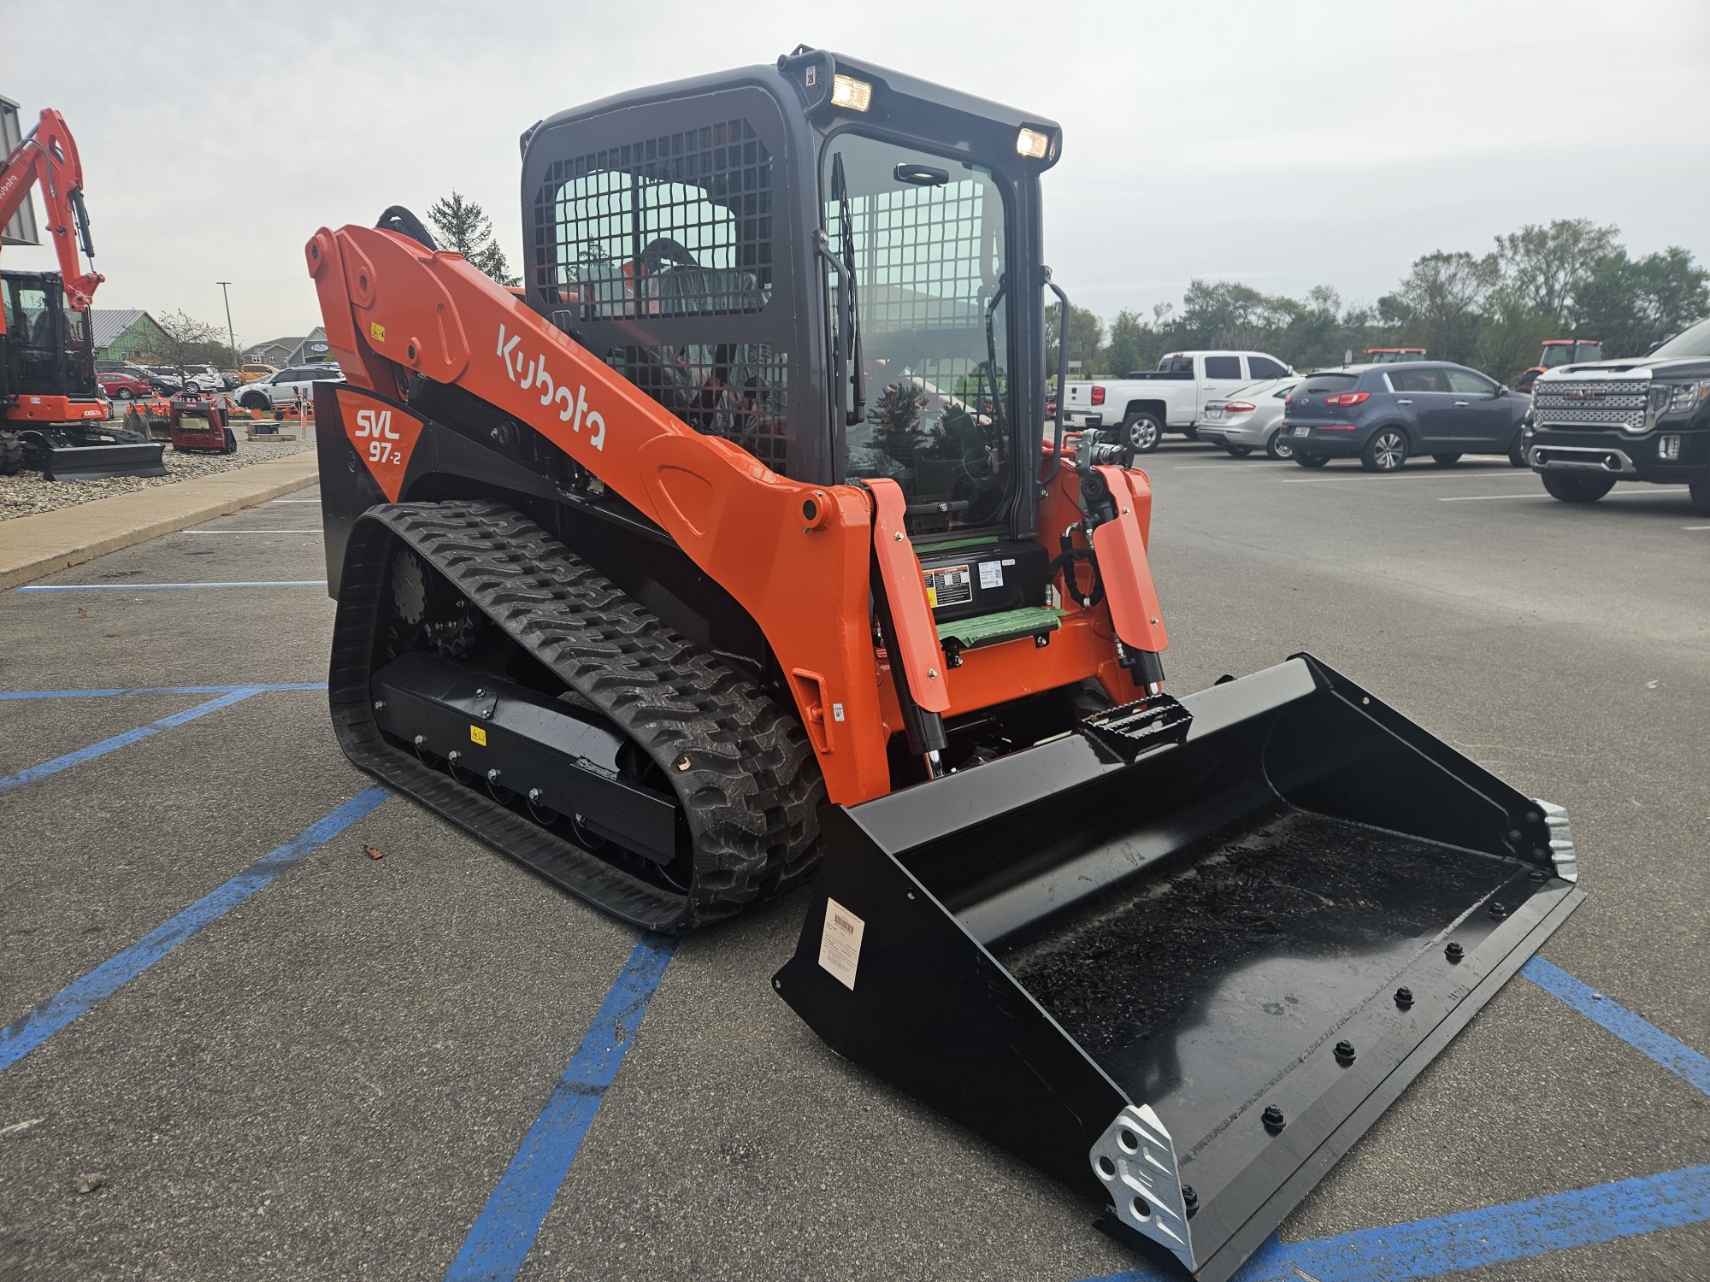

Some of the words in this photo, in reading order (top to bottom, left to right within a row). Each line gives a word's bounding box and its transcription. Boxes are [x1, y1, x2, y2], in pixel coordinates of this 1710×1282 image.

[0, 175, 17, 199] ubota
[496, 323, 606, 452] Kubota
[355, 409, 400, 440] SVL
[369, 440, 401, 465] 97-2
